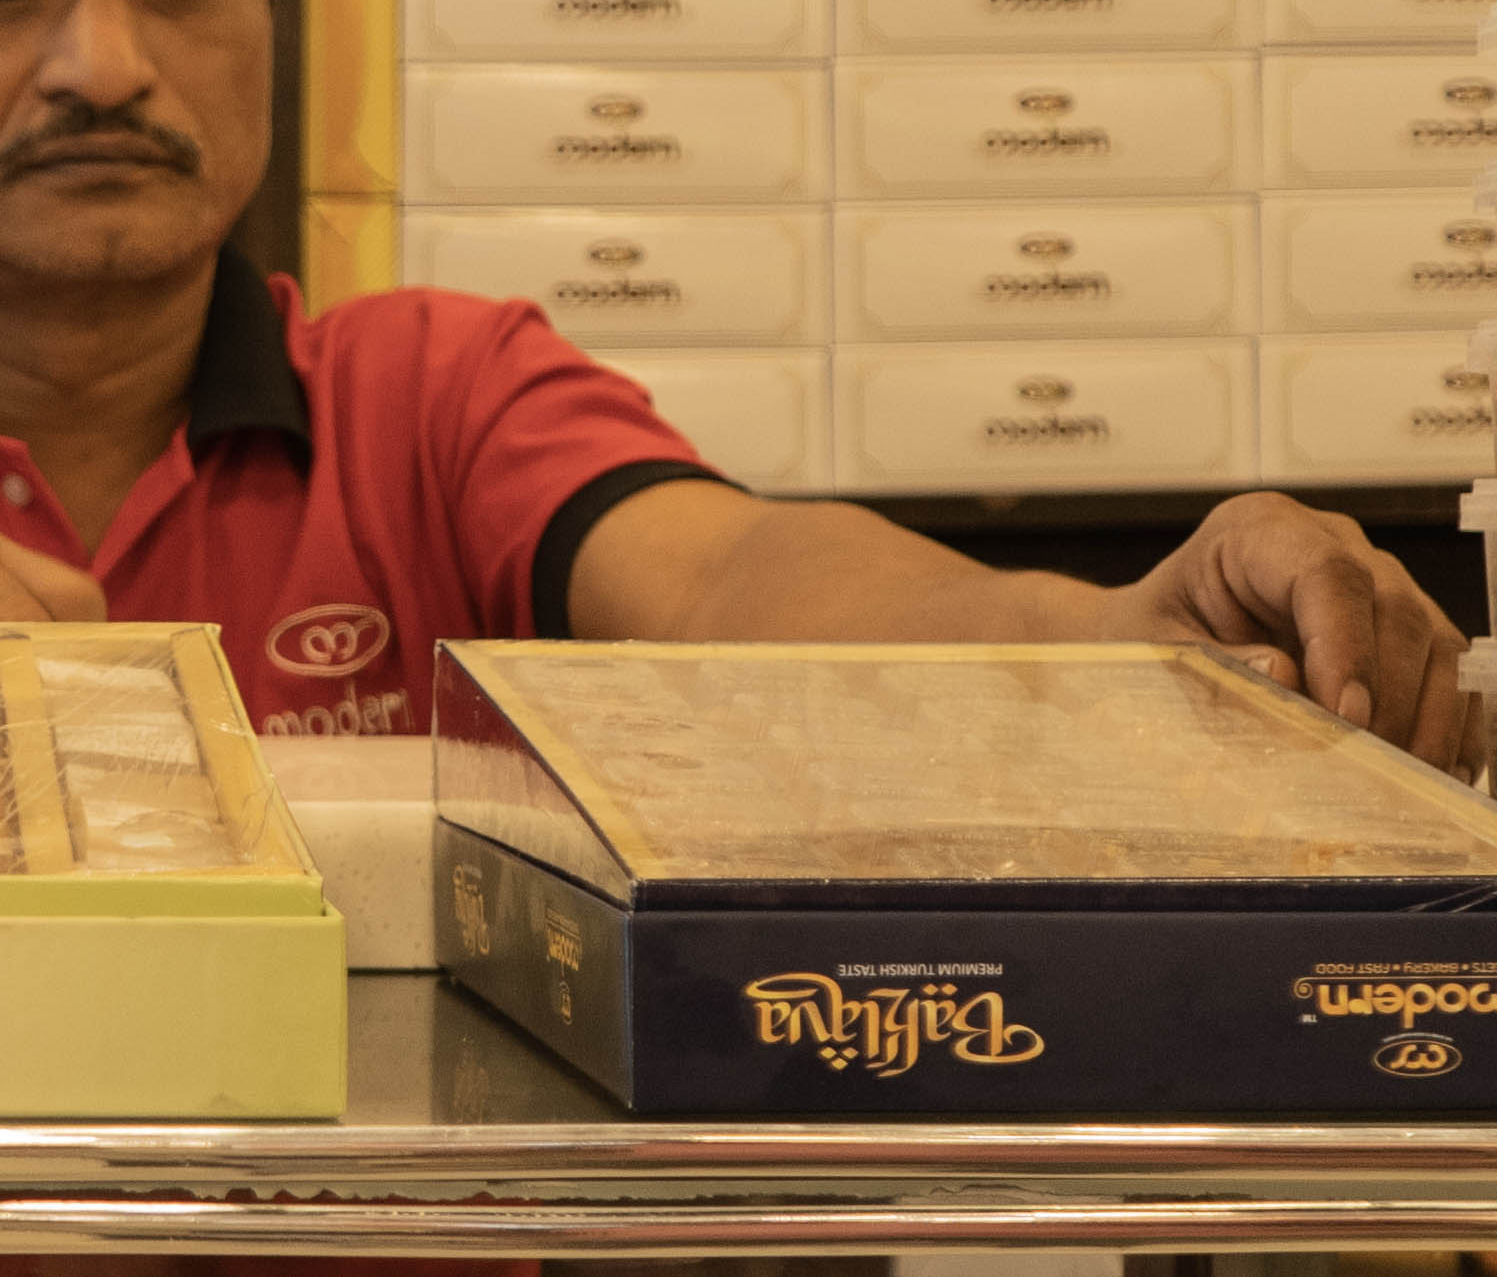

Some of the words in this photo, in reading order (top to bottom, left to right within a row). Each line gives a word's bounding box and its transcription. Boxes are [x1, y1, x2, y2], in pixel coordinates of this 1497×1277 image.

[839, 964, 876, 977] TASTE
[880, 964, 934, 976] TURKISH
[938, 963, 1002, 976] PREMIUM
[1316, 964, 1354, 973] FOOD
[1358, 963, 1390, 973] FAST
[1404, 962, 1458, 973] BAKERY
[741, 973, 1045, 1080] Baklava
